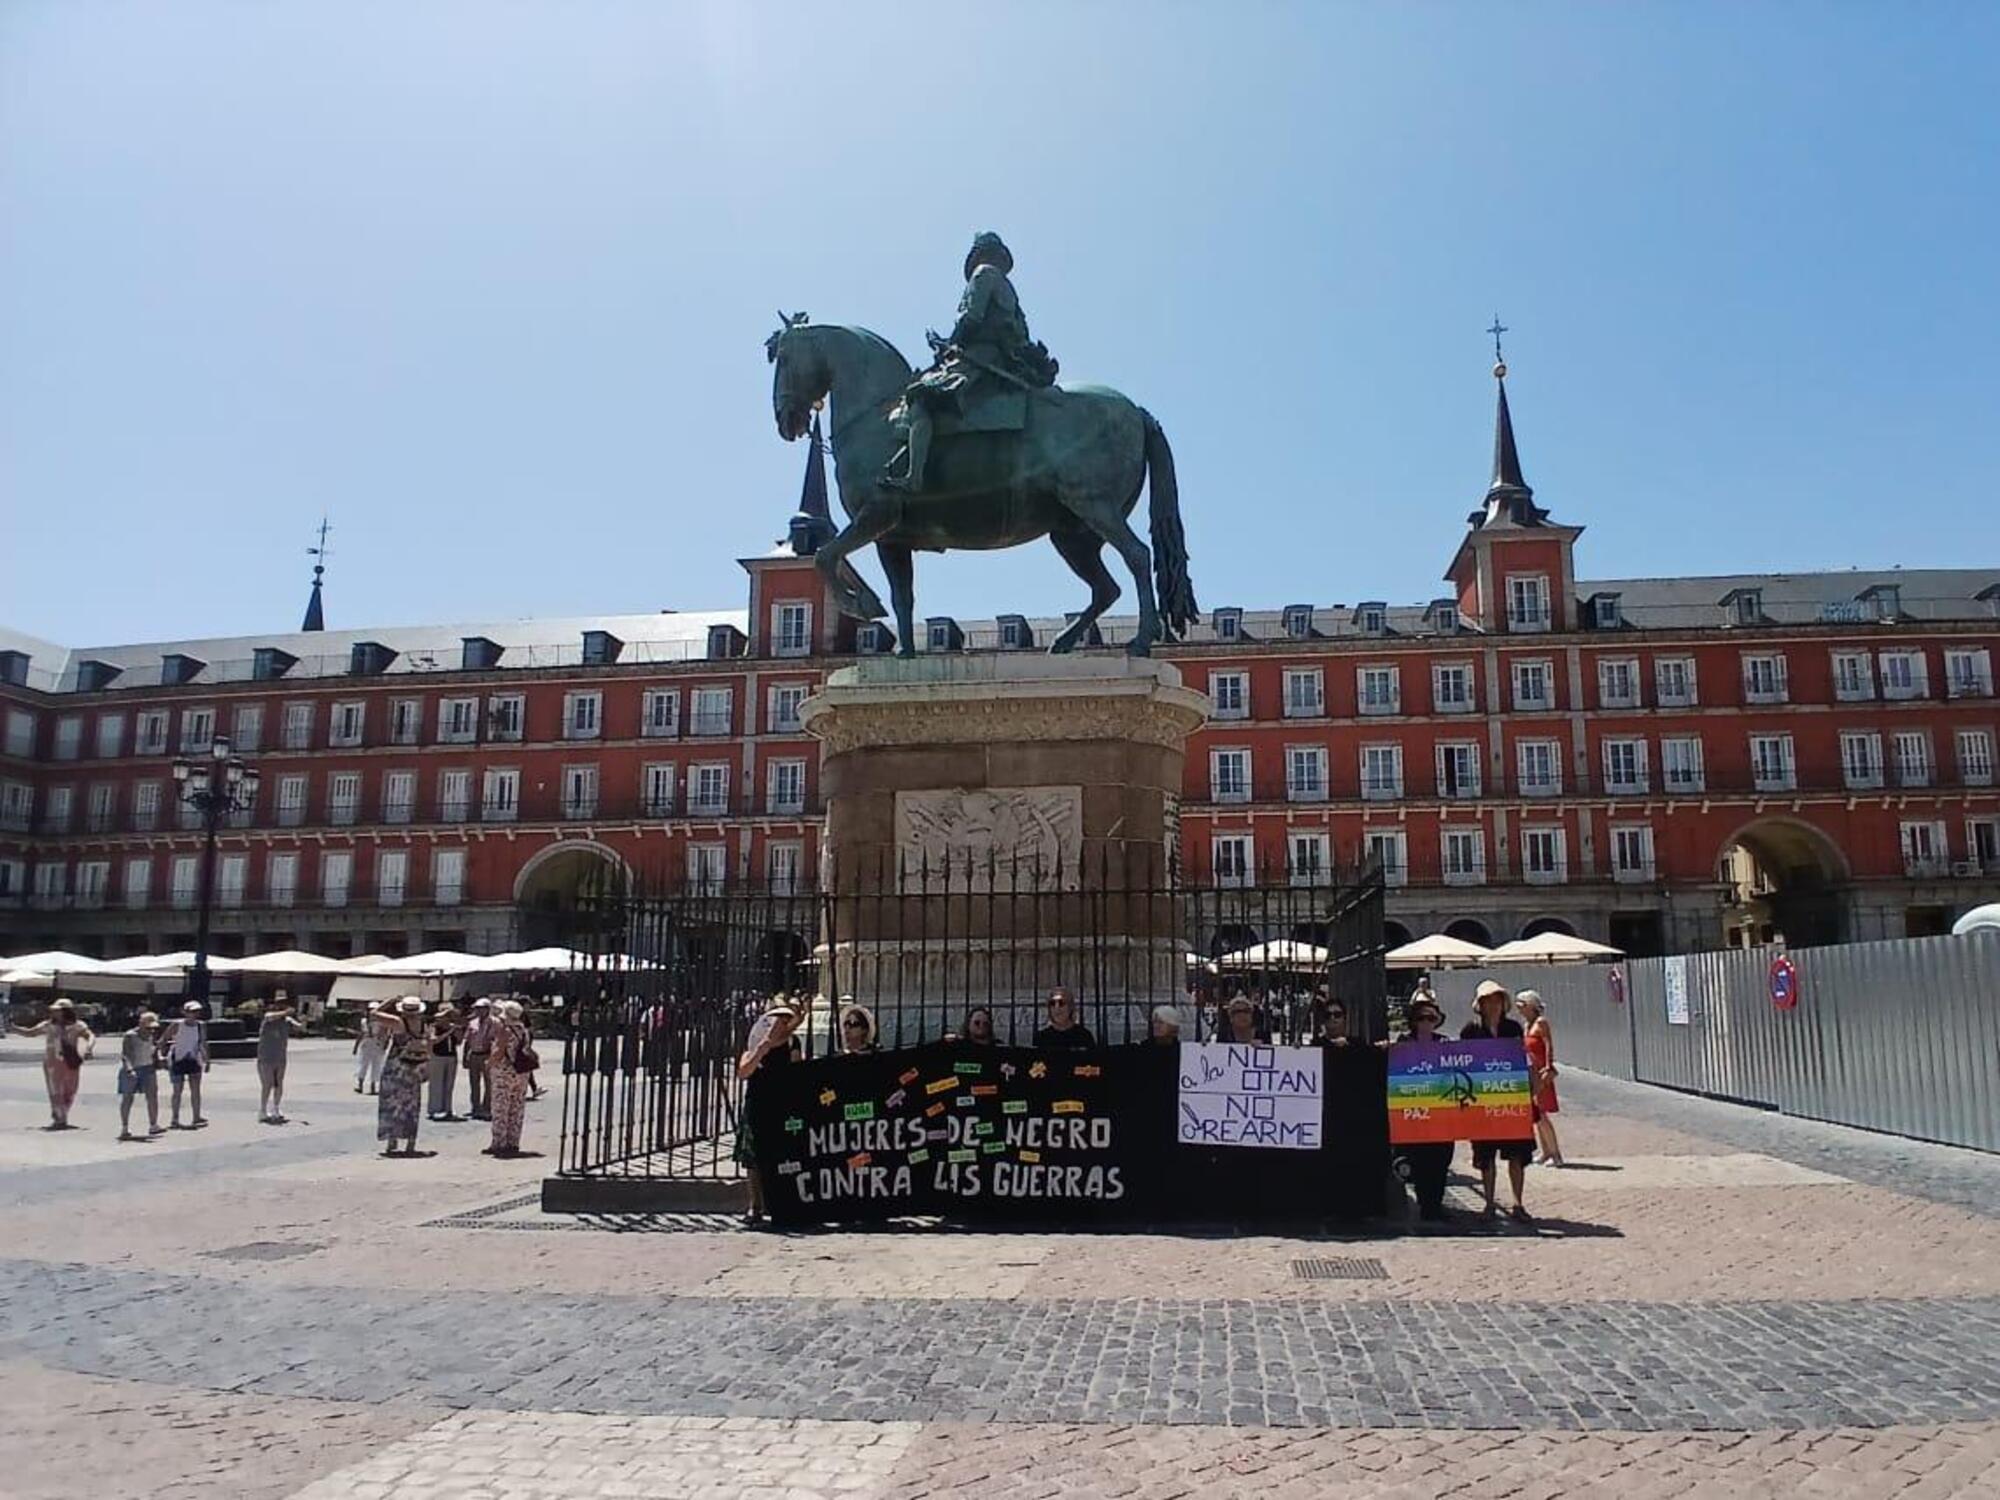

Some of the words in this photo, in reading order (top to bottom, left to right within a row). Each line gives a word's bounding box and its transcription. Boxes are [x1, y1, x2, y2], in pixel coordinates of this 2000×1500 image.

[1228, 1046, 1275, 1069] NO
[1181, 1075, 1197, 1089] a
[1201, 1055, 1224, 1082] la
[1242, 1070, 1316, 1093] OTAN
[1482, 1080, 1520, 1093] PACE
[1226, 1096, 1275, 1120] NO
[1403, 1107, 1431, 1120] PAZ
[809, 1117, 927, 1157] MUJERES
[947, 1115, 981, 1146] DE
[1006, 1117, 1110, 1149] NEGRO
[1202, 1119, 1319, 1146] REARME
[797, 1165, 912, 1202] CONTRA
[993, 1161, 1124, 1199] GUERRAS
